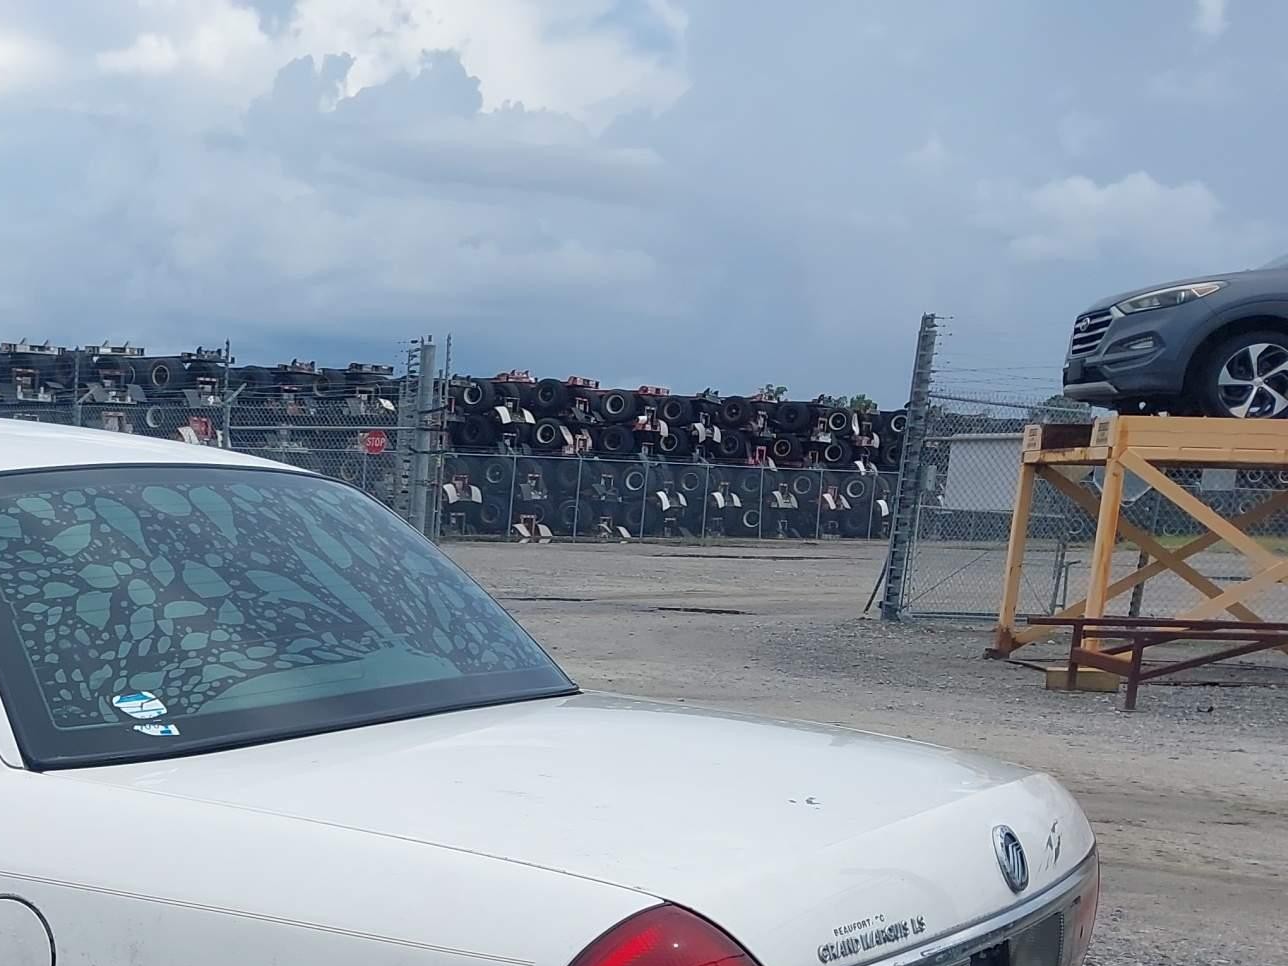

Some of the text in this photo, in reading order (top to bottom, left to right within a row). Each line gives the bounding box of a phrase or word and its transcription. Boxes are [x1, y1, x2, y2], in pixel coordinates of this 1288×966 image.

[366, 437, 386, 447] STOP
[875, 913, 886, 923] C
[817, 914, 927, 964] GRAND MARQUIS LS
